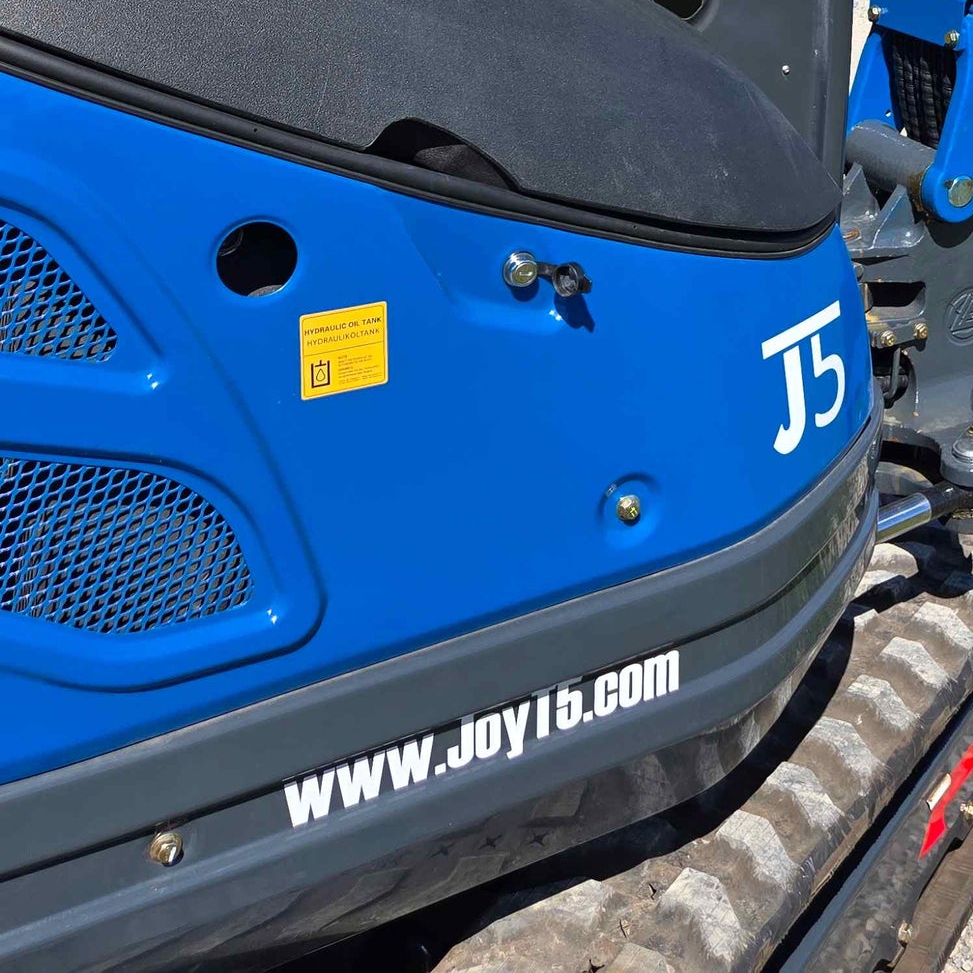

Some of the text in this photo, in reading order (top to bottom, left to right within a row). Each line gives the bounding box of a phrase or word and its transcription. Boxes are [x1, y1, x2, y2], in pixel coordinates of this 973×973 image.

[304, 316, 382, 337] HYDRAULIC OIL TANK
